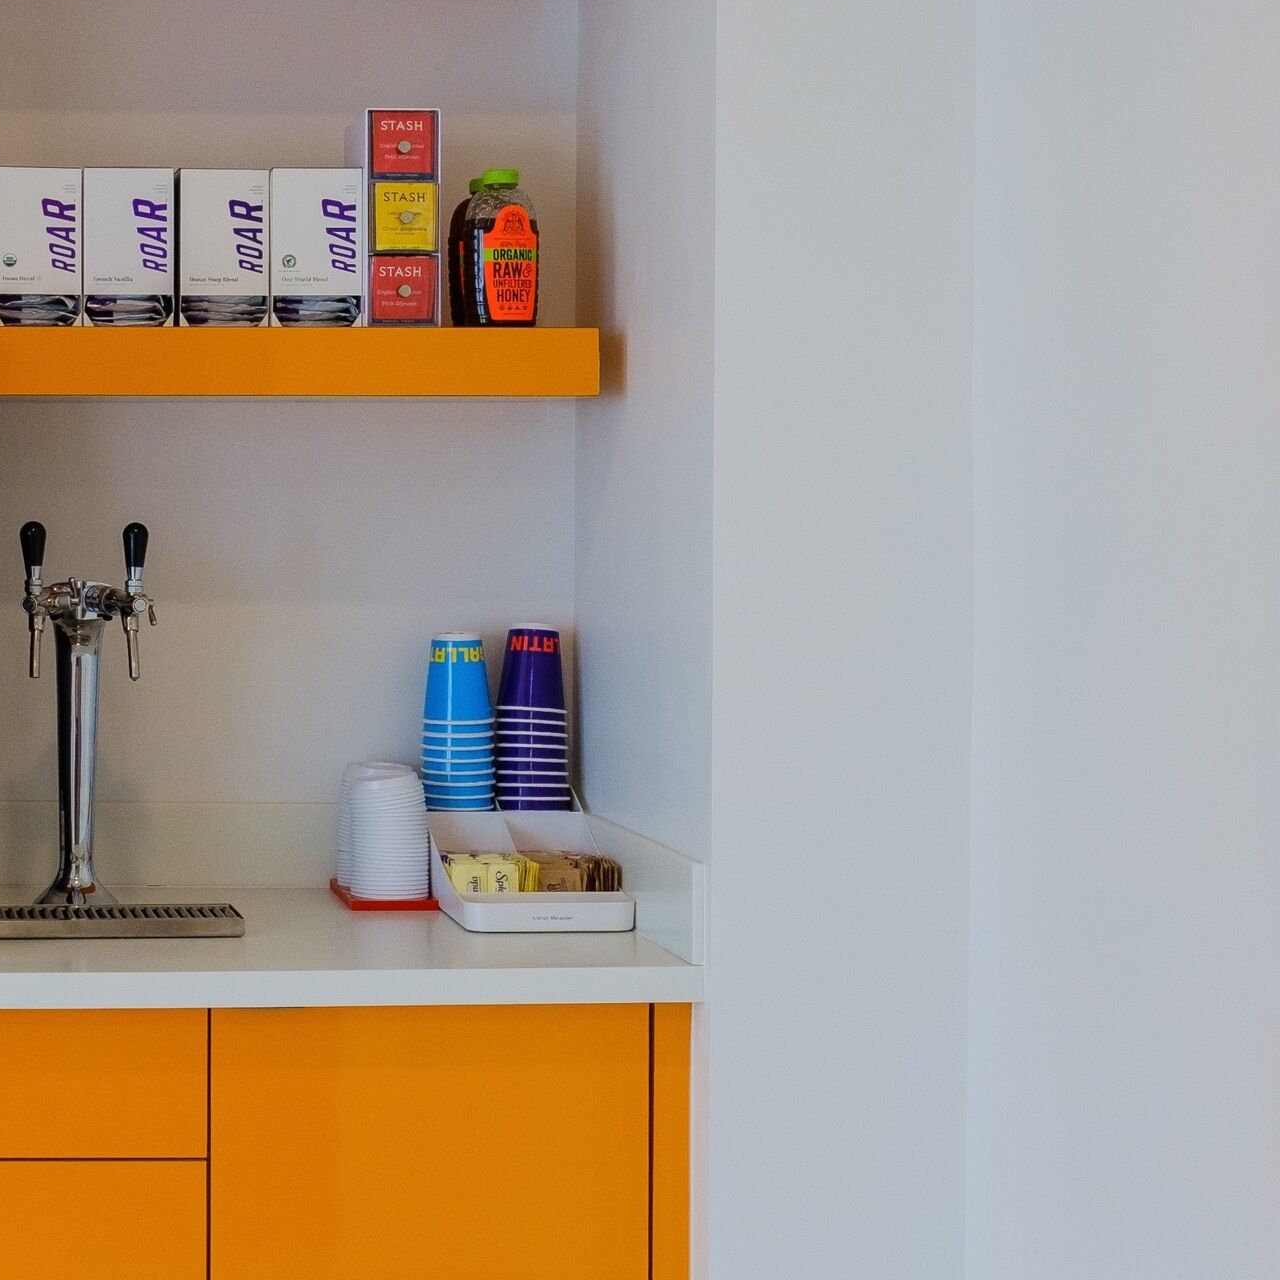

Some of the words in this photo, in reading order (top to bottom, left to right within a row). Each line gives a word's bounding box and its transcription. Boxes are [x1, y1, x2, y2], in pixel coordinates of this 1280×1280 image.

[380, 120, 423, 132] STASH
[383, 191, 426, 203] STASH
[41, 197, 76, 273] ROAR
[132, 198, 168, 273] ROAR
[228, 199, 264, 274] ROAR
[321, 198, 357, 274] ROAR
[493, 248, 533, 261] ORGANIC
[379, 266, 422, 277] STASH
[493, 261, 523, 278] RAW
[522, 263, 533, 278] &
[493, 279, 532, 289] UNFILTERED
[496, 288, 531, 303] HONEY
